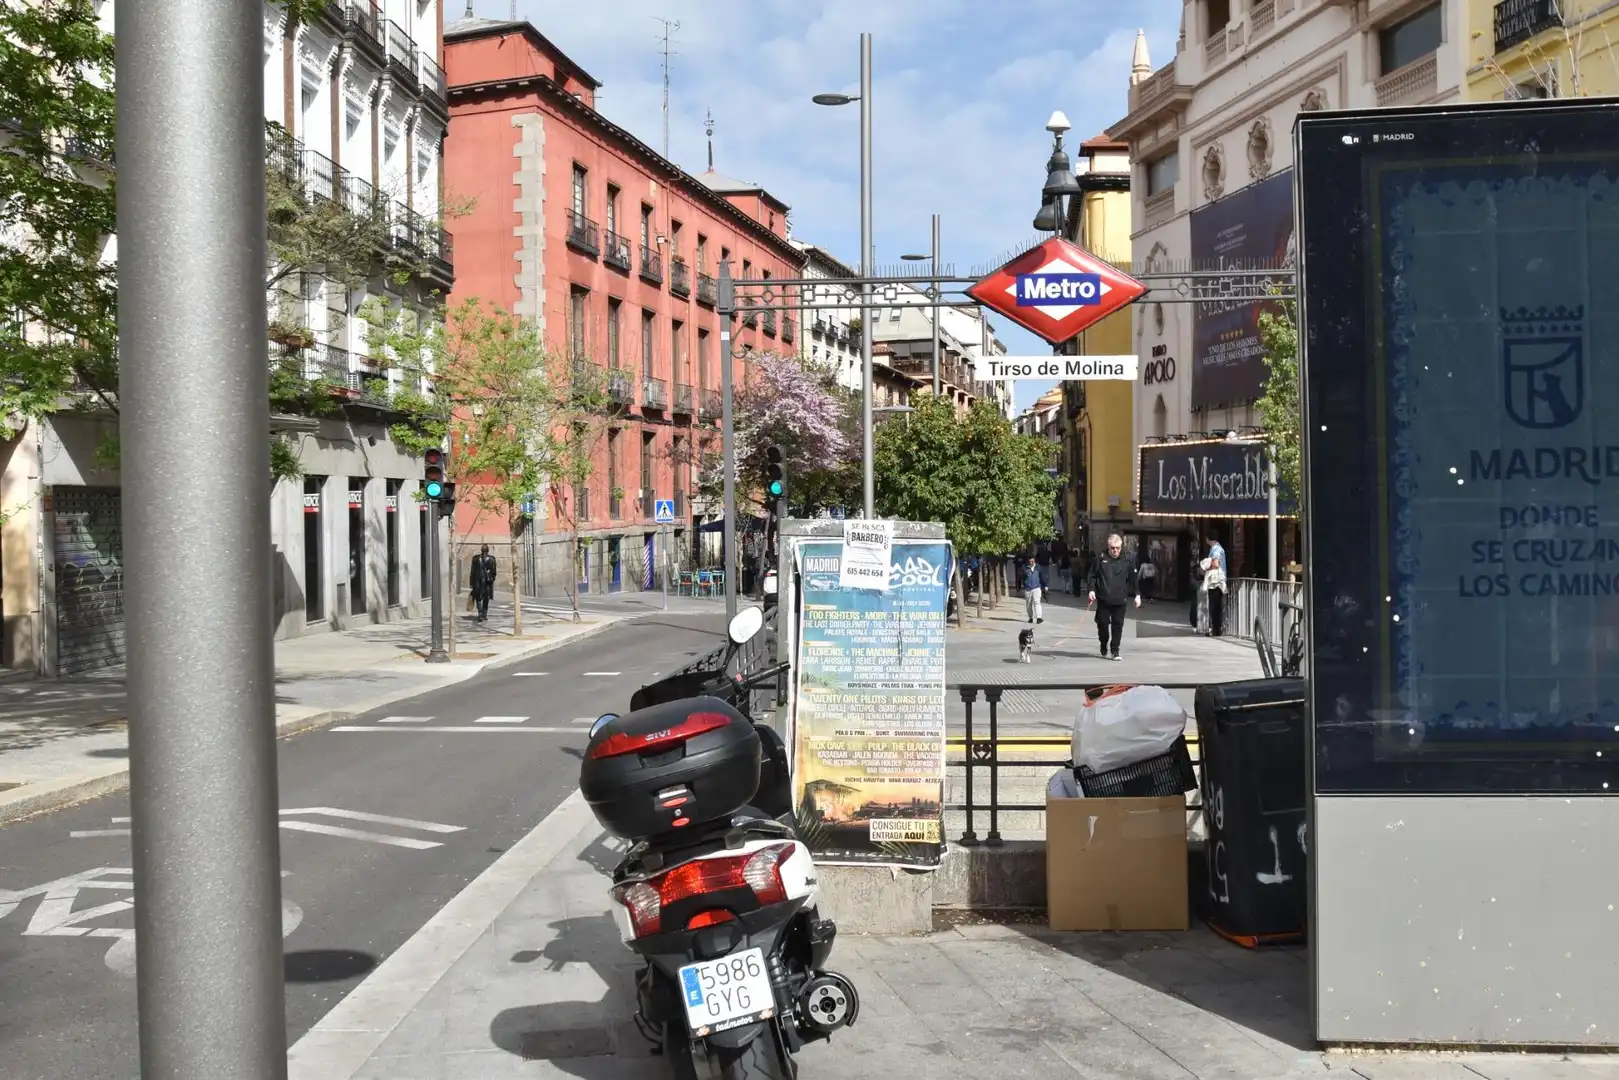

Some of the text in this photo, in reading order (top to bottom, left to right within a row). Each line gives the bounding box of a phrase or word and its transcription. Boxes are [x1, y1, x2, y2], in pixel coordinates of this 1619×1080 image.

[1383, 133, 1414, 141] MADRID
[1024, 277, 1096, 299] Metro
[988, 360, 1124, 376] Tirso de Molina
[1144, 357, 1176, 385] APOLO
[1157, 452, 1279, 500] Los Miserable
[1500, 505, 1599, 530] DONDE
[851, 532, 884, 544] BARBERO
[1471, 540, 1503, 564] SE
[806, 557, 839, 572] MADRID
[847, 567, 883, 577] 615 442 654
[1459, 574, 1511, 598] LOS
[809, 611, 824, 620] FOO
[825, 611, 860, 620] FIGHTERS
[865, 611, 888, 621] MOBY
[893, 612, 908, 620] THE
[909, 612, 928, 620] WAR
[808, 648, 844, 656] FLORENCE
[851, 648, 865, 656] THE
[866, 648, 900, 657] MACHINE
[809, 694, 842, 703] TWENTY
[843, 695, 859, 703] ONE
[860, 695, 887, 704] PILOTS
[892, 696, 916, 704] KINGS
[917, 696, 928, 704] OF
[645, 729, 671, 741] GIVI
[808, 741, 826, 750] NICK
[827, 742, 846, 750] CAVE
[868, 742, 887, 751] PULP
[892, 742, 906, 751] THE
[907, 742, 930, 751] BLACK
[817, 751, 848, 759] KASABIAN
[872, 821, 925, 830] CONSIGUE TU
[872, 831, 903, 840] ENTRADA
[700, 954, 761, 990] 5986
[690, 989, 699, 1001] E
[706, 985, 751, 1017] GYG
